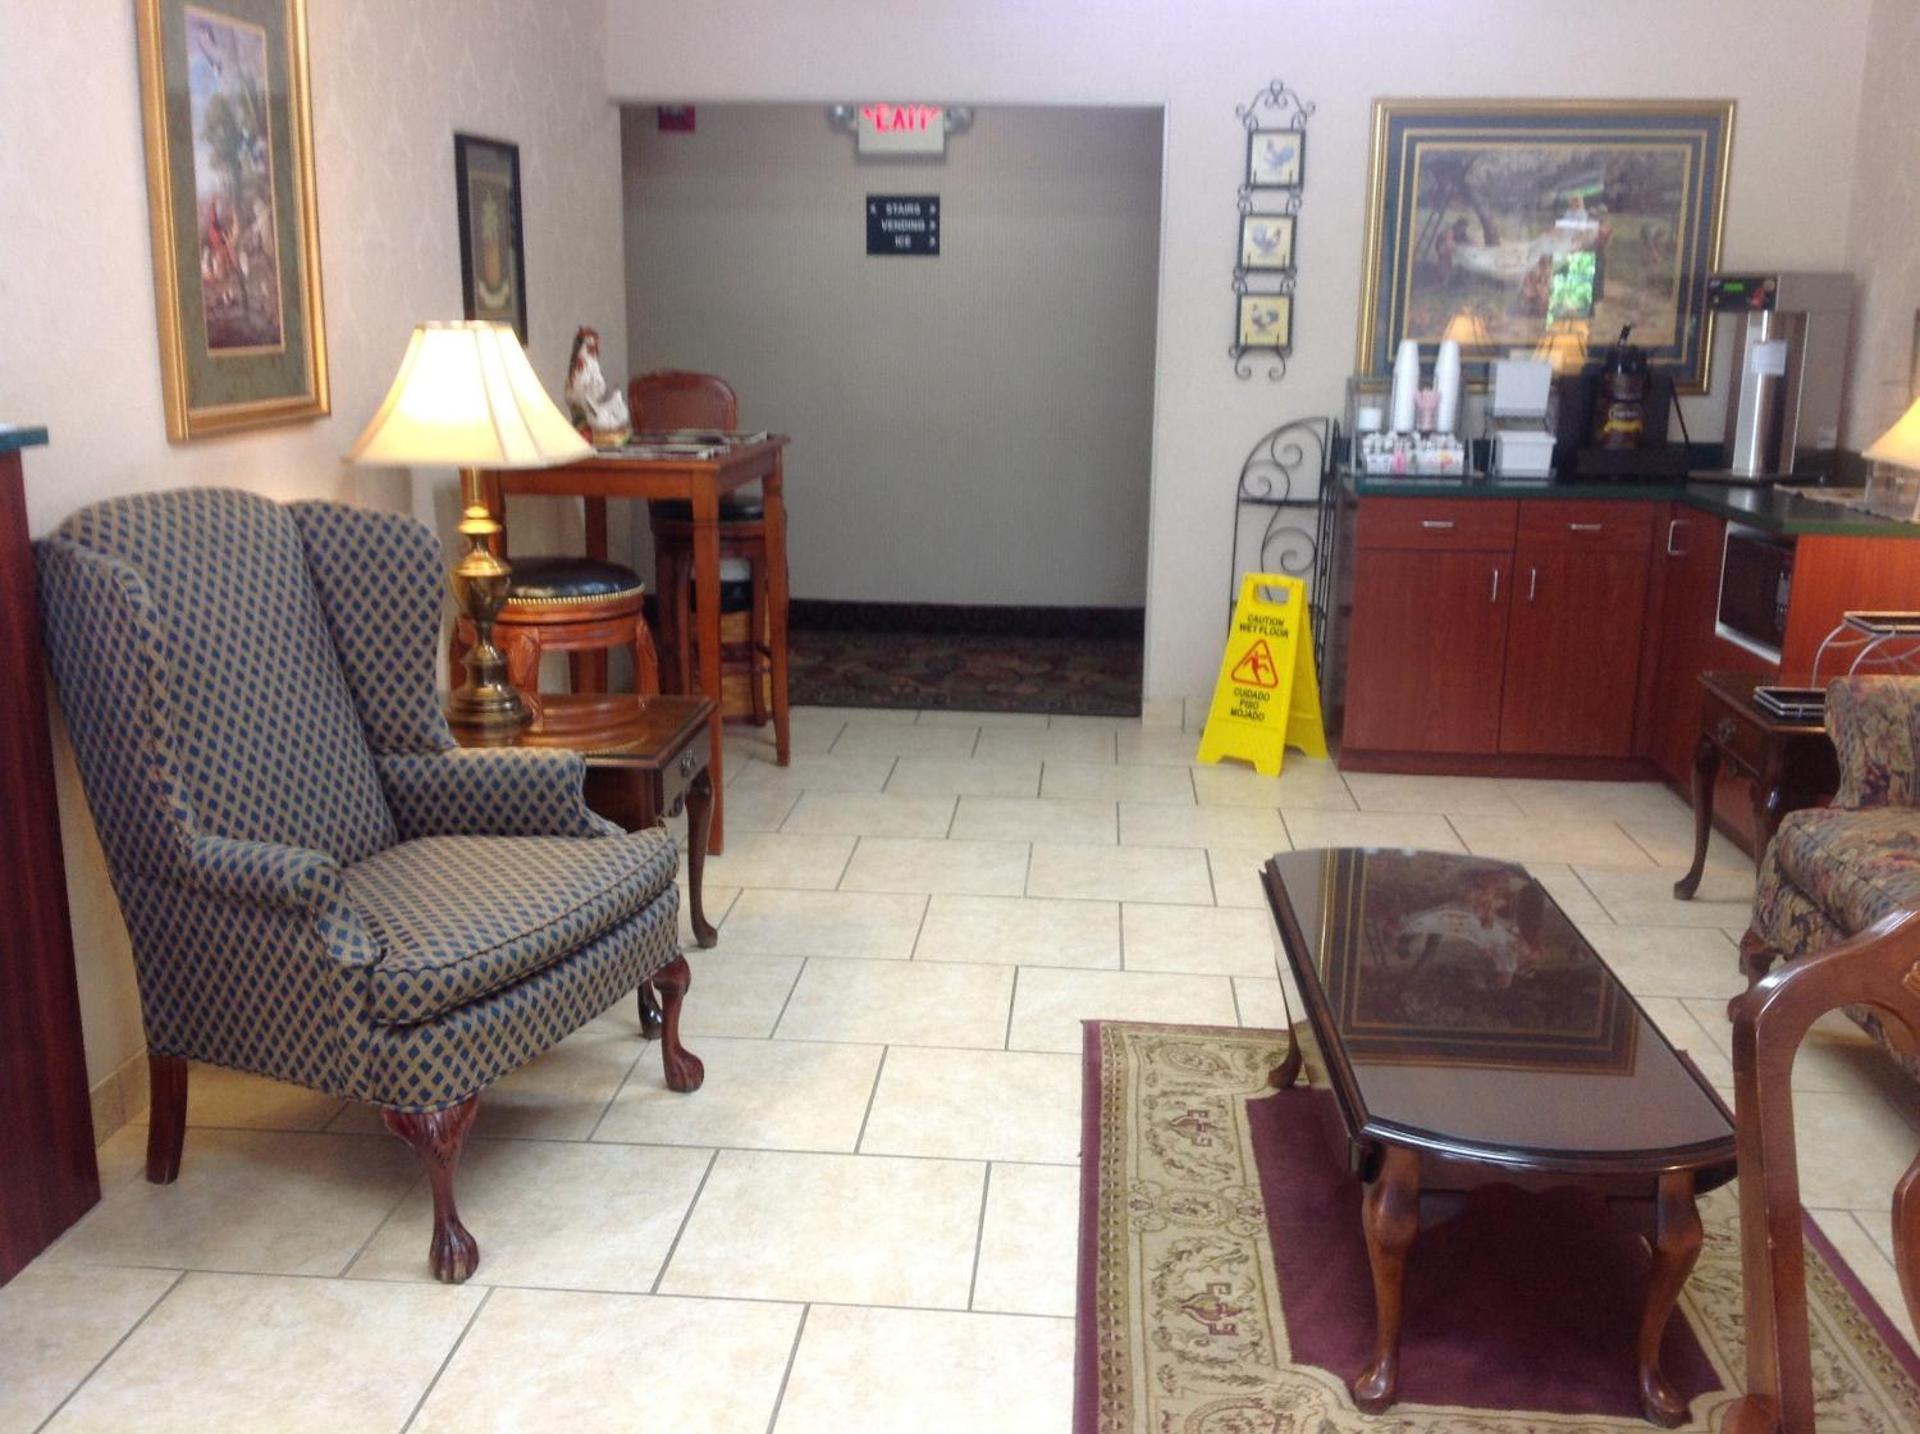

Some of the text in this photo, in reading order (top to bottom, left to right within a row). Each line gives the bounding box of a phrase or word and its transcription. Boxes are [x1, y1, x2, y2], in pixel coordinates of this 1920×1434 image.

[1247, 614, 1284, 626] CAUTION
[1239, 623, 1289, 639] WET FLOOR
[1233, 687, 1271, 702] CUIDADO
[1239, 699, 1259, 710] PISO
[1230, 707, 1265, 722] MOJADO
